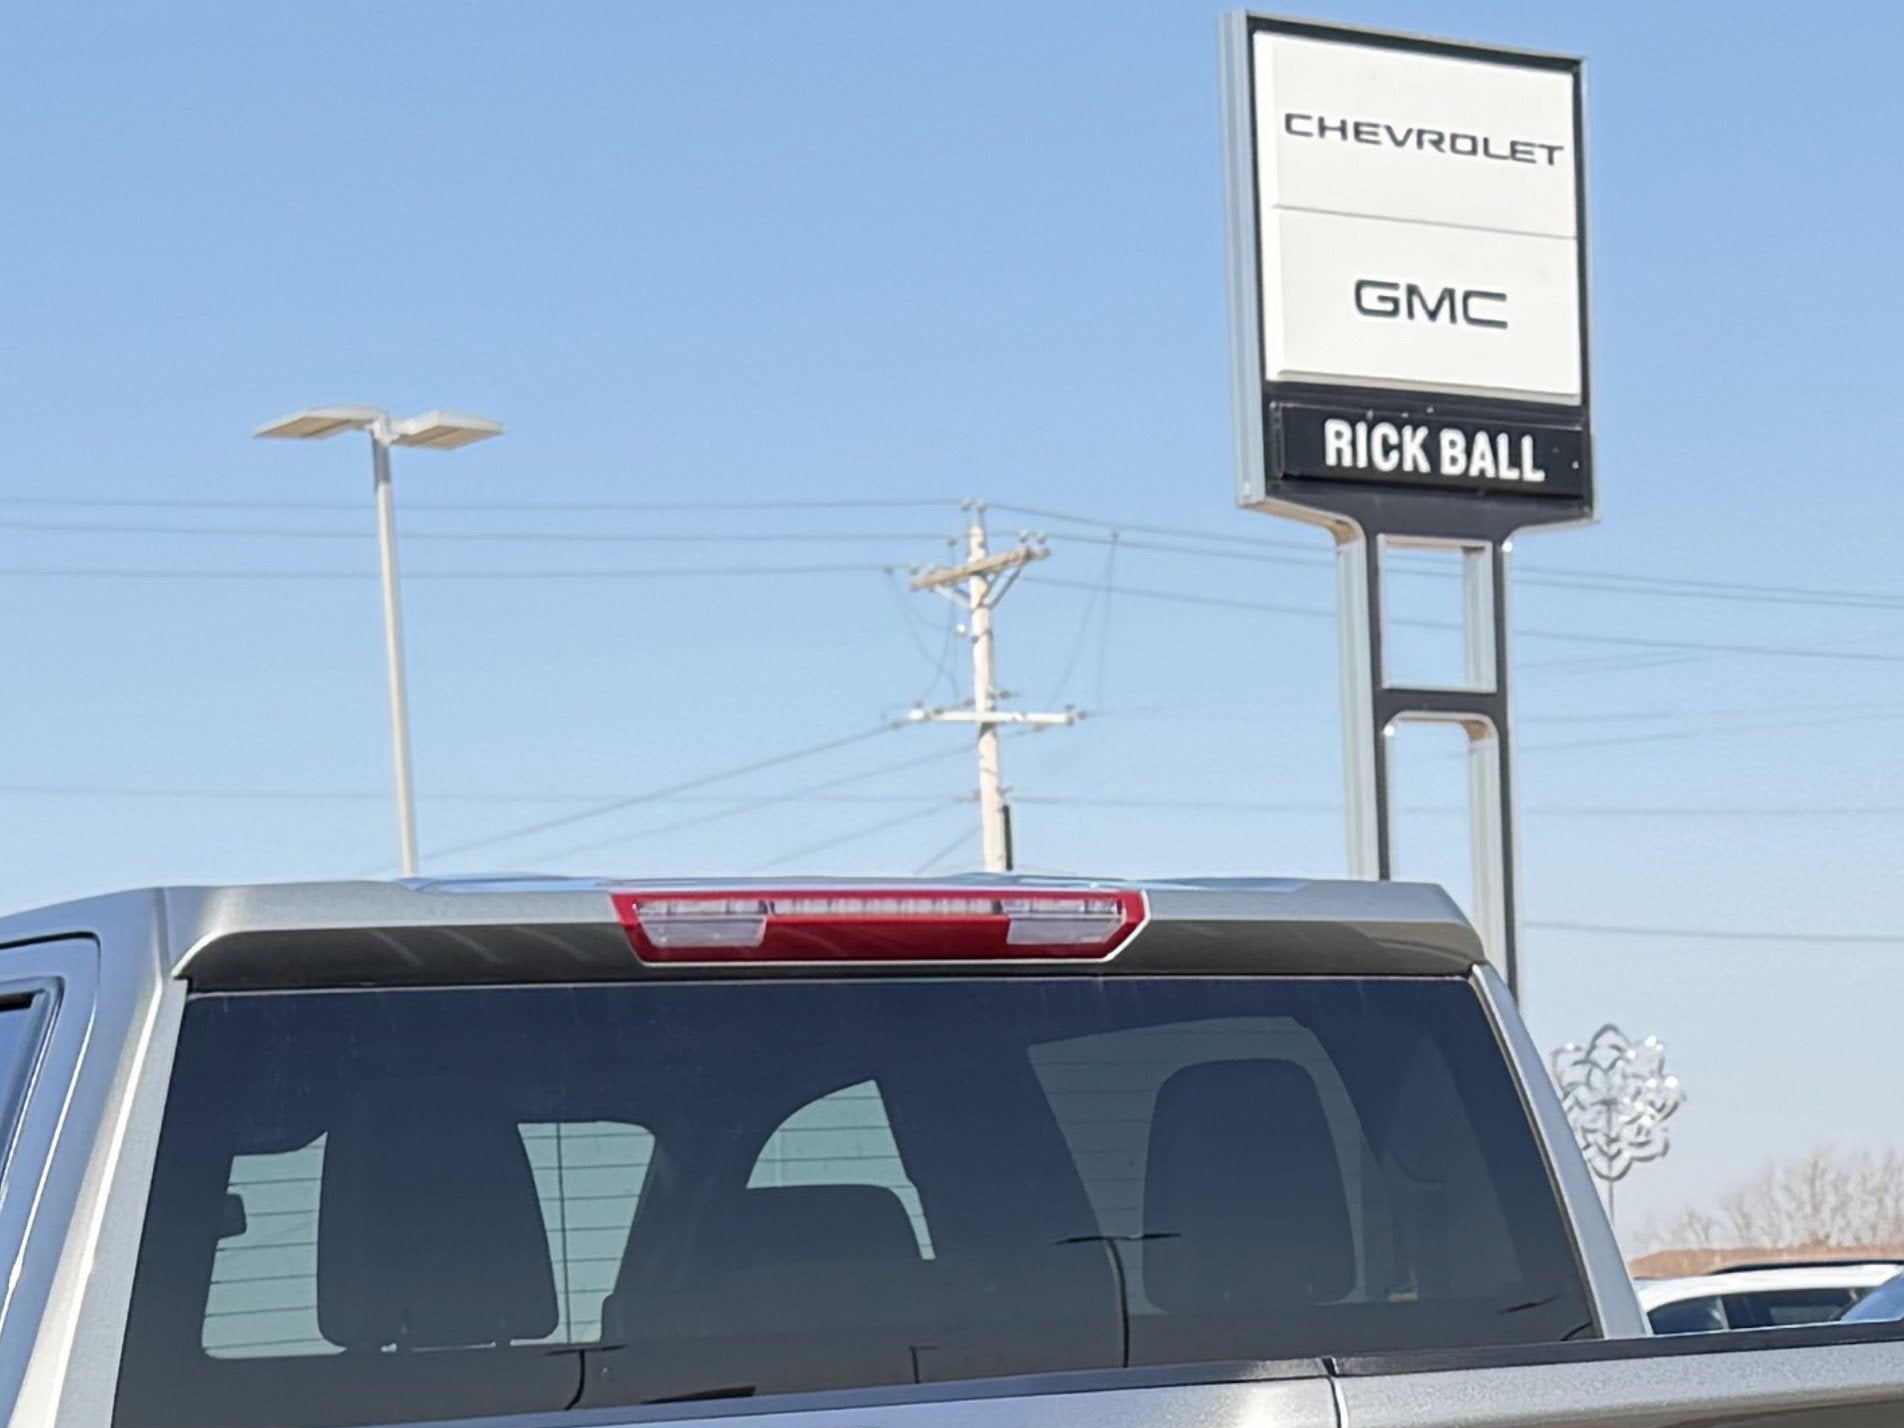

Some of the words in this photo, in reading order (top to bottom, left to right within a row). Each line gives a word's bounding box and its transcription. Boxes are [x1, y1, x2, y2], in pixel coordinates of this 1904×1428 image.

[1283, 113, 1564, 166] CHEVROLET
[1355, 278, 1508, 329] GMC
[1324, 418, 1430, 474] RICK
[1439, 427, 1545, 482] BALL
